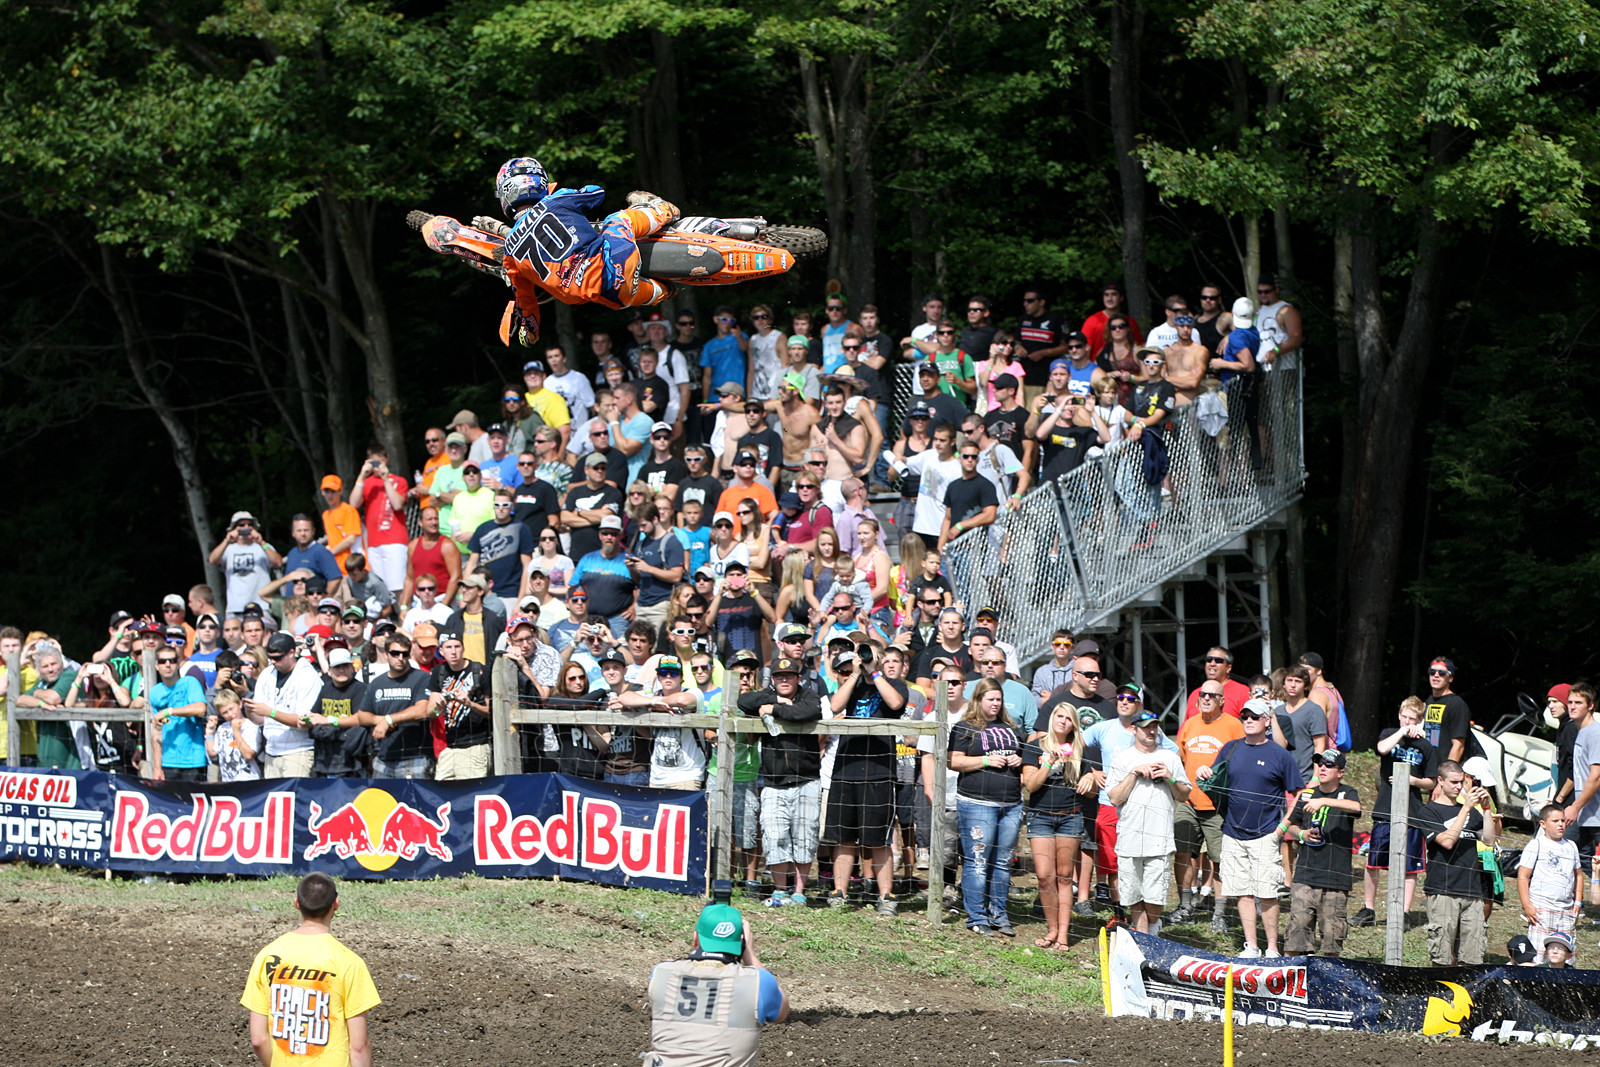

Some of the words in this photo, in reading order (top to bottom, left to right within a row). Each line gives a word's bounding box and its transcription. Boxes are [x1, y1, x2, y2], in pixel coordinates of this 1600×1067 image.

[511, 211, 575, 283] 70
[43, 778, 71, 803] OIL
[5, 804, 47, 817] PRO
[278, 965, 337, 982] thor
[1177, 960, 1263, 994] LUCAS
[1266, 968, 1307, 999] OIL
[270, 983, 330, 1018] TRACK
[677, 975, 719, 1019] 51
[271, 1012, 330, 1053] CREW
